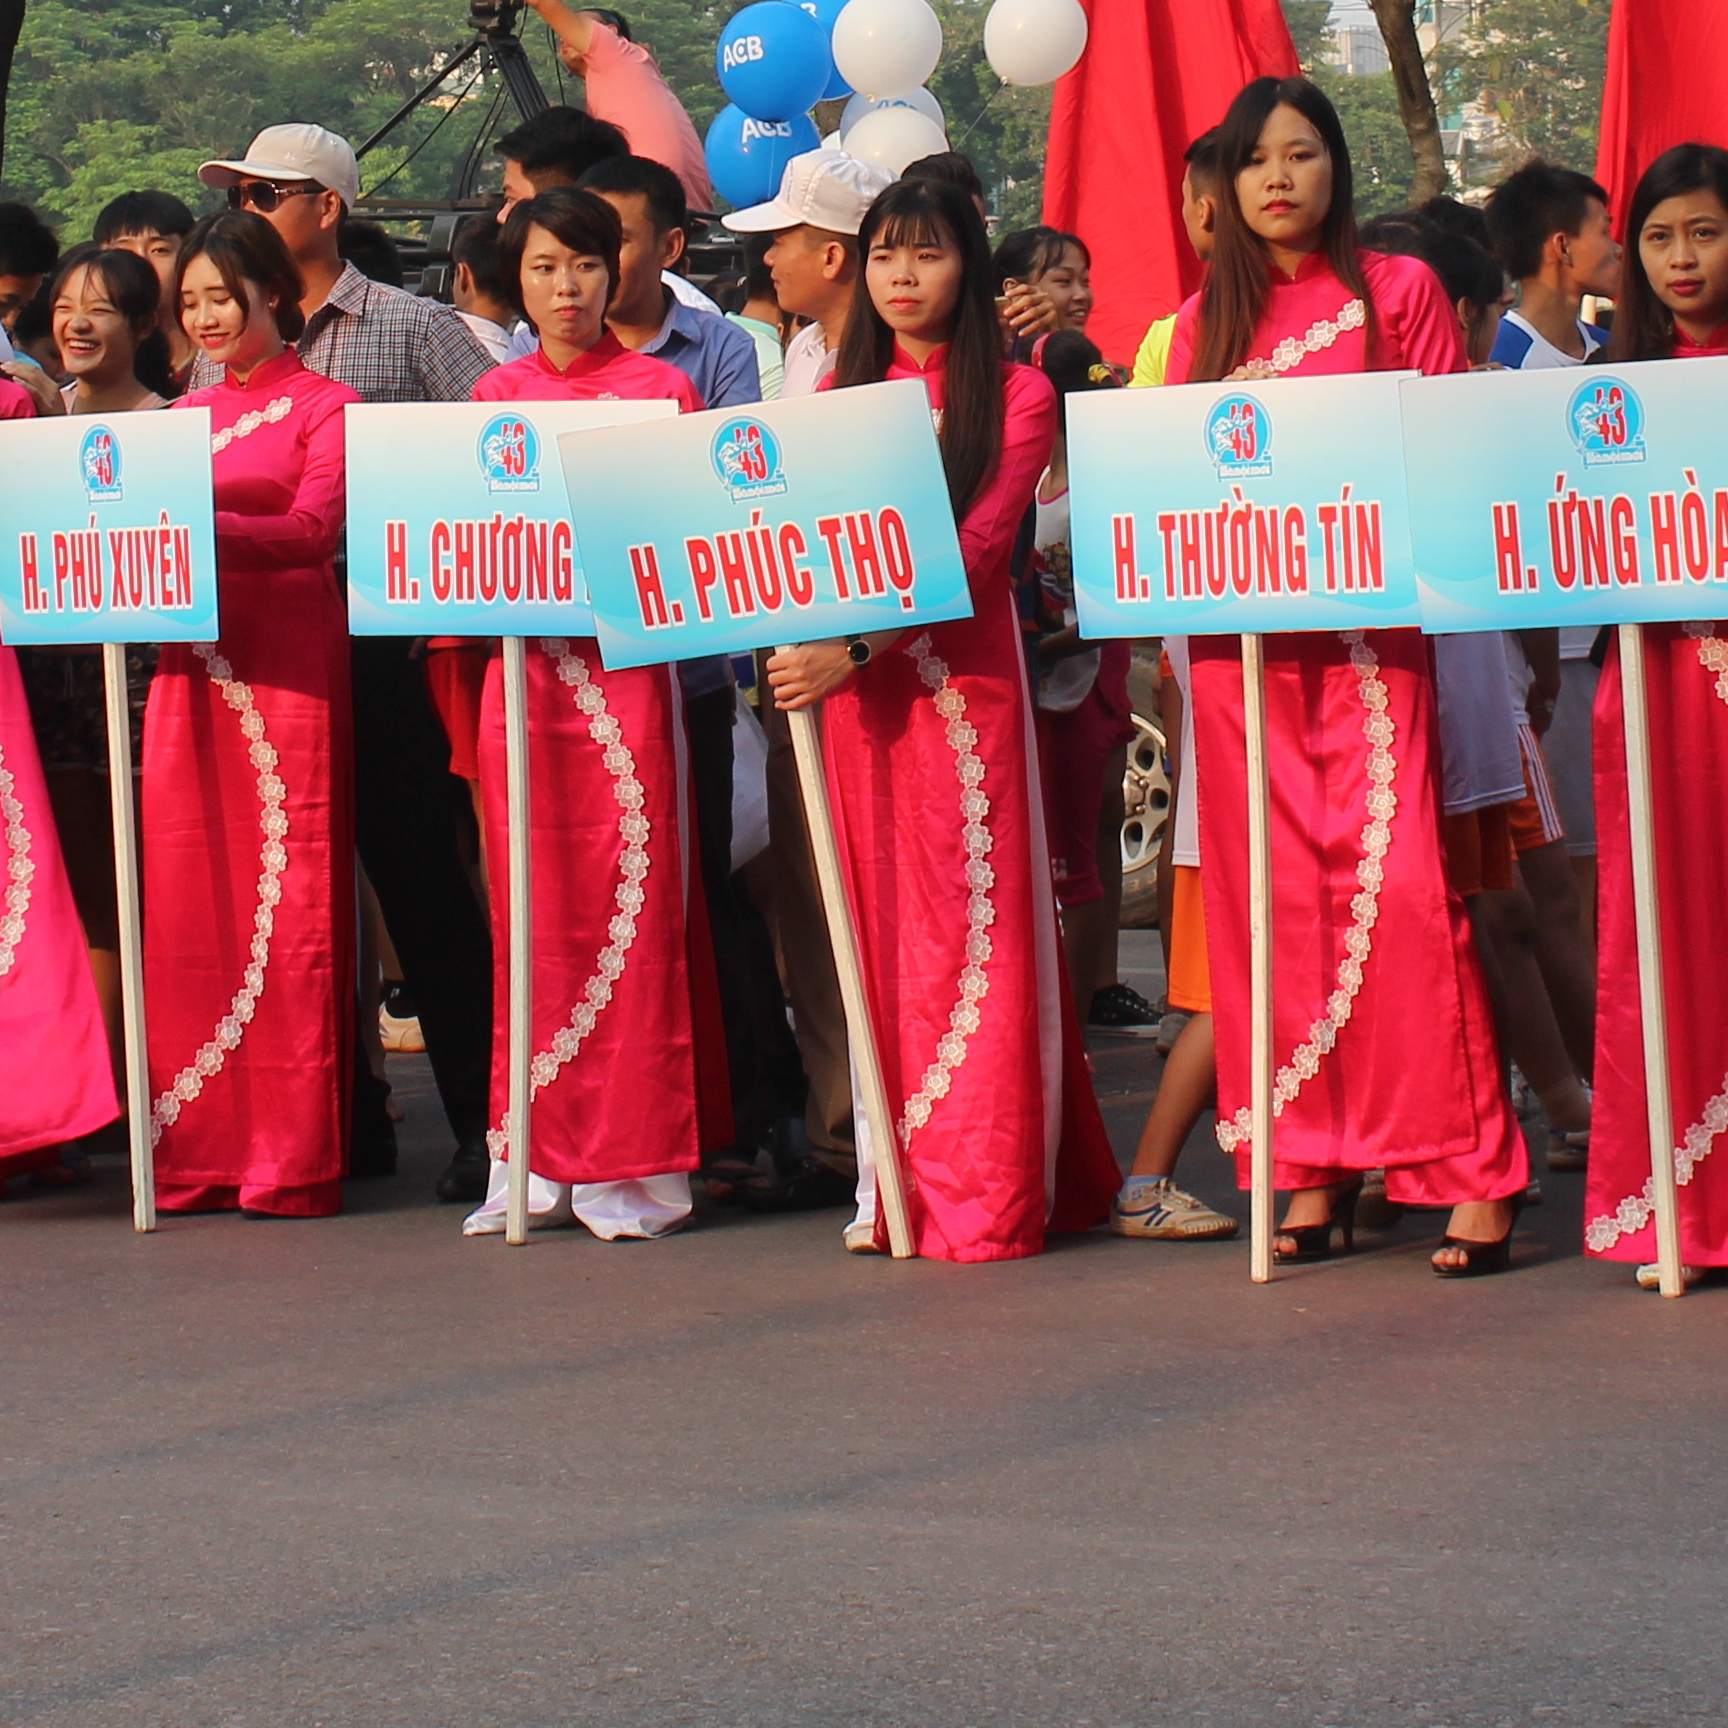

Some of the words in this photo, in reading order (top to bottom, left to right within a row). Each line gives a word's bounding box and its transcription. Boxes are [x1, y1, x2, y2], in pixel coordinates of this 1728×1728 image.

[723, 35, 764, 73] ACB
[19, 533, 50, 612] H.
[52, 511, 105, 611] PHÚ
[107, 509, 194, 610] XUYÊN
[385, 520, 421, 602] H.
[429, 512, 575, 603] CHƯƠNG
[628, 544, 686, 629] H.
[684, 509, 816, 621] PHÚC
[816, 506, 916, 611] THỌ
[1111, 514, 1151, 601] H.
[1156, 485, 1310, 599] THƯỜNG
[1316, 484, 1385, 592] TÍN
[1491, 502, 1539, 593] H.
[1547, 473, 1642, 590] ỨNG
